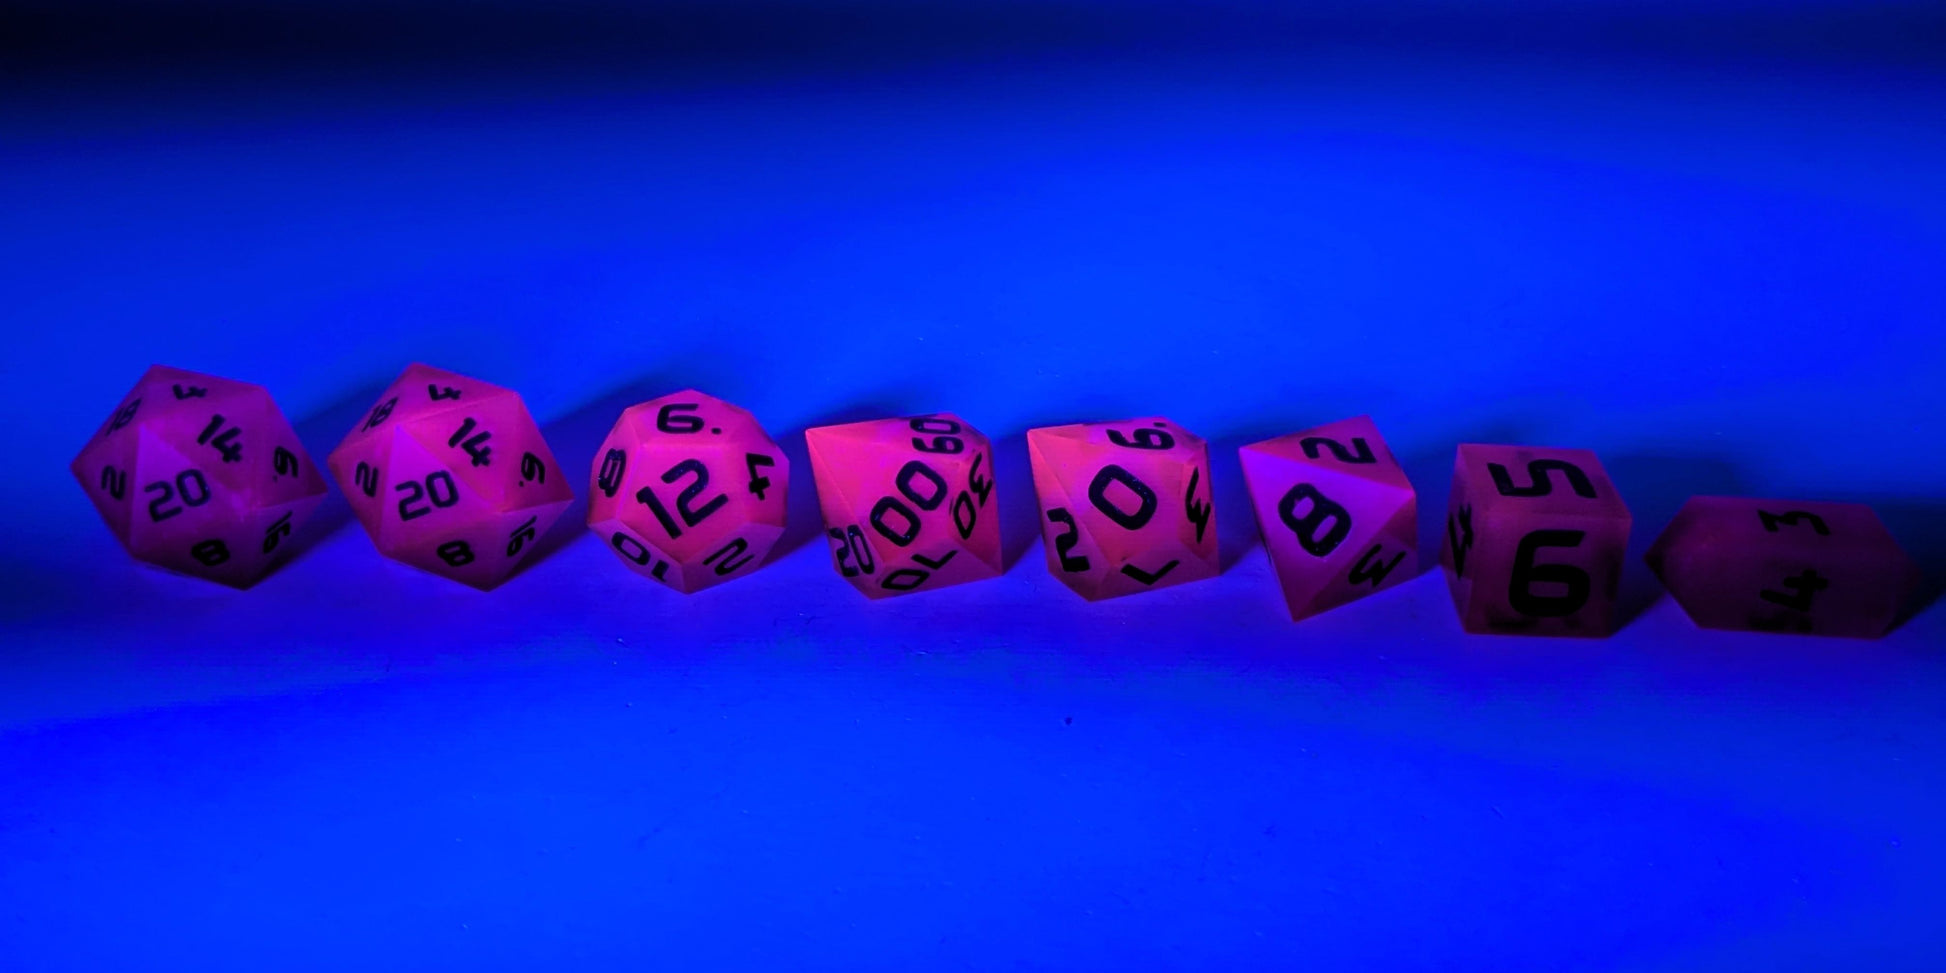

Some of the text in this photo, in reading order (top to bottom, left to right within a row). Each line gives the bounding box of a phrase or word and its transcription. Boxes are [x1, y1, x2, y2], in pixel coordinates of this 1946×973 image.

[172, 383, 207, 399] 4
[428, 384, 462, 400] 4
[197, 414, 242, 462] 14
[449, 417, 492, 467] 14
[1300, 437, 1377, 464] 2
[101, 464, 127, 500] 2
[144, 468, 211, 522] 20
[355, 461, 379, 497] 2
[395, 470, 459, 521] 20
[599, 448, 627, 498] 8
[746, 452, 775, 501] 4
[1088, 464, 1157, 531] 0
[1487, 459, 1598, 499] 5
[636, 458, 729, 539] 12
[869, 460, 949, 548] 00
[1278, 482, 1352, 558] 8
[1757, 509, 1830, 535] 3
[190, 539, 230, 566] 8
[437, 541, 474, 567] 8
[702, 537, 754, 576] 2
[828, 524, 875, 578] 20
[1046, 507, 1090, 573] 2
[1508, 528, 1590, 618] 6
